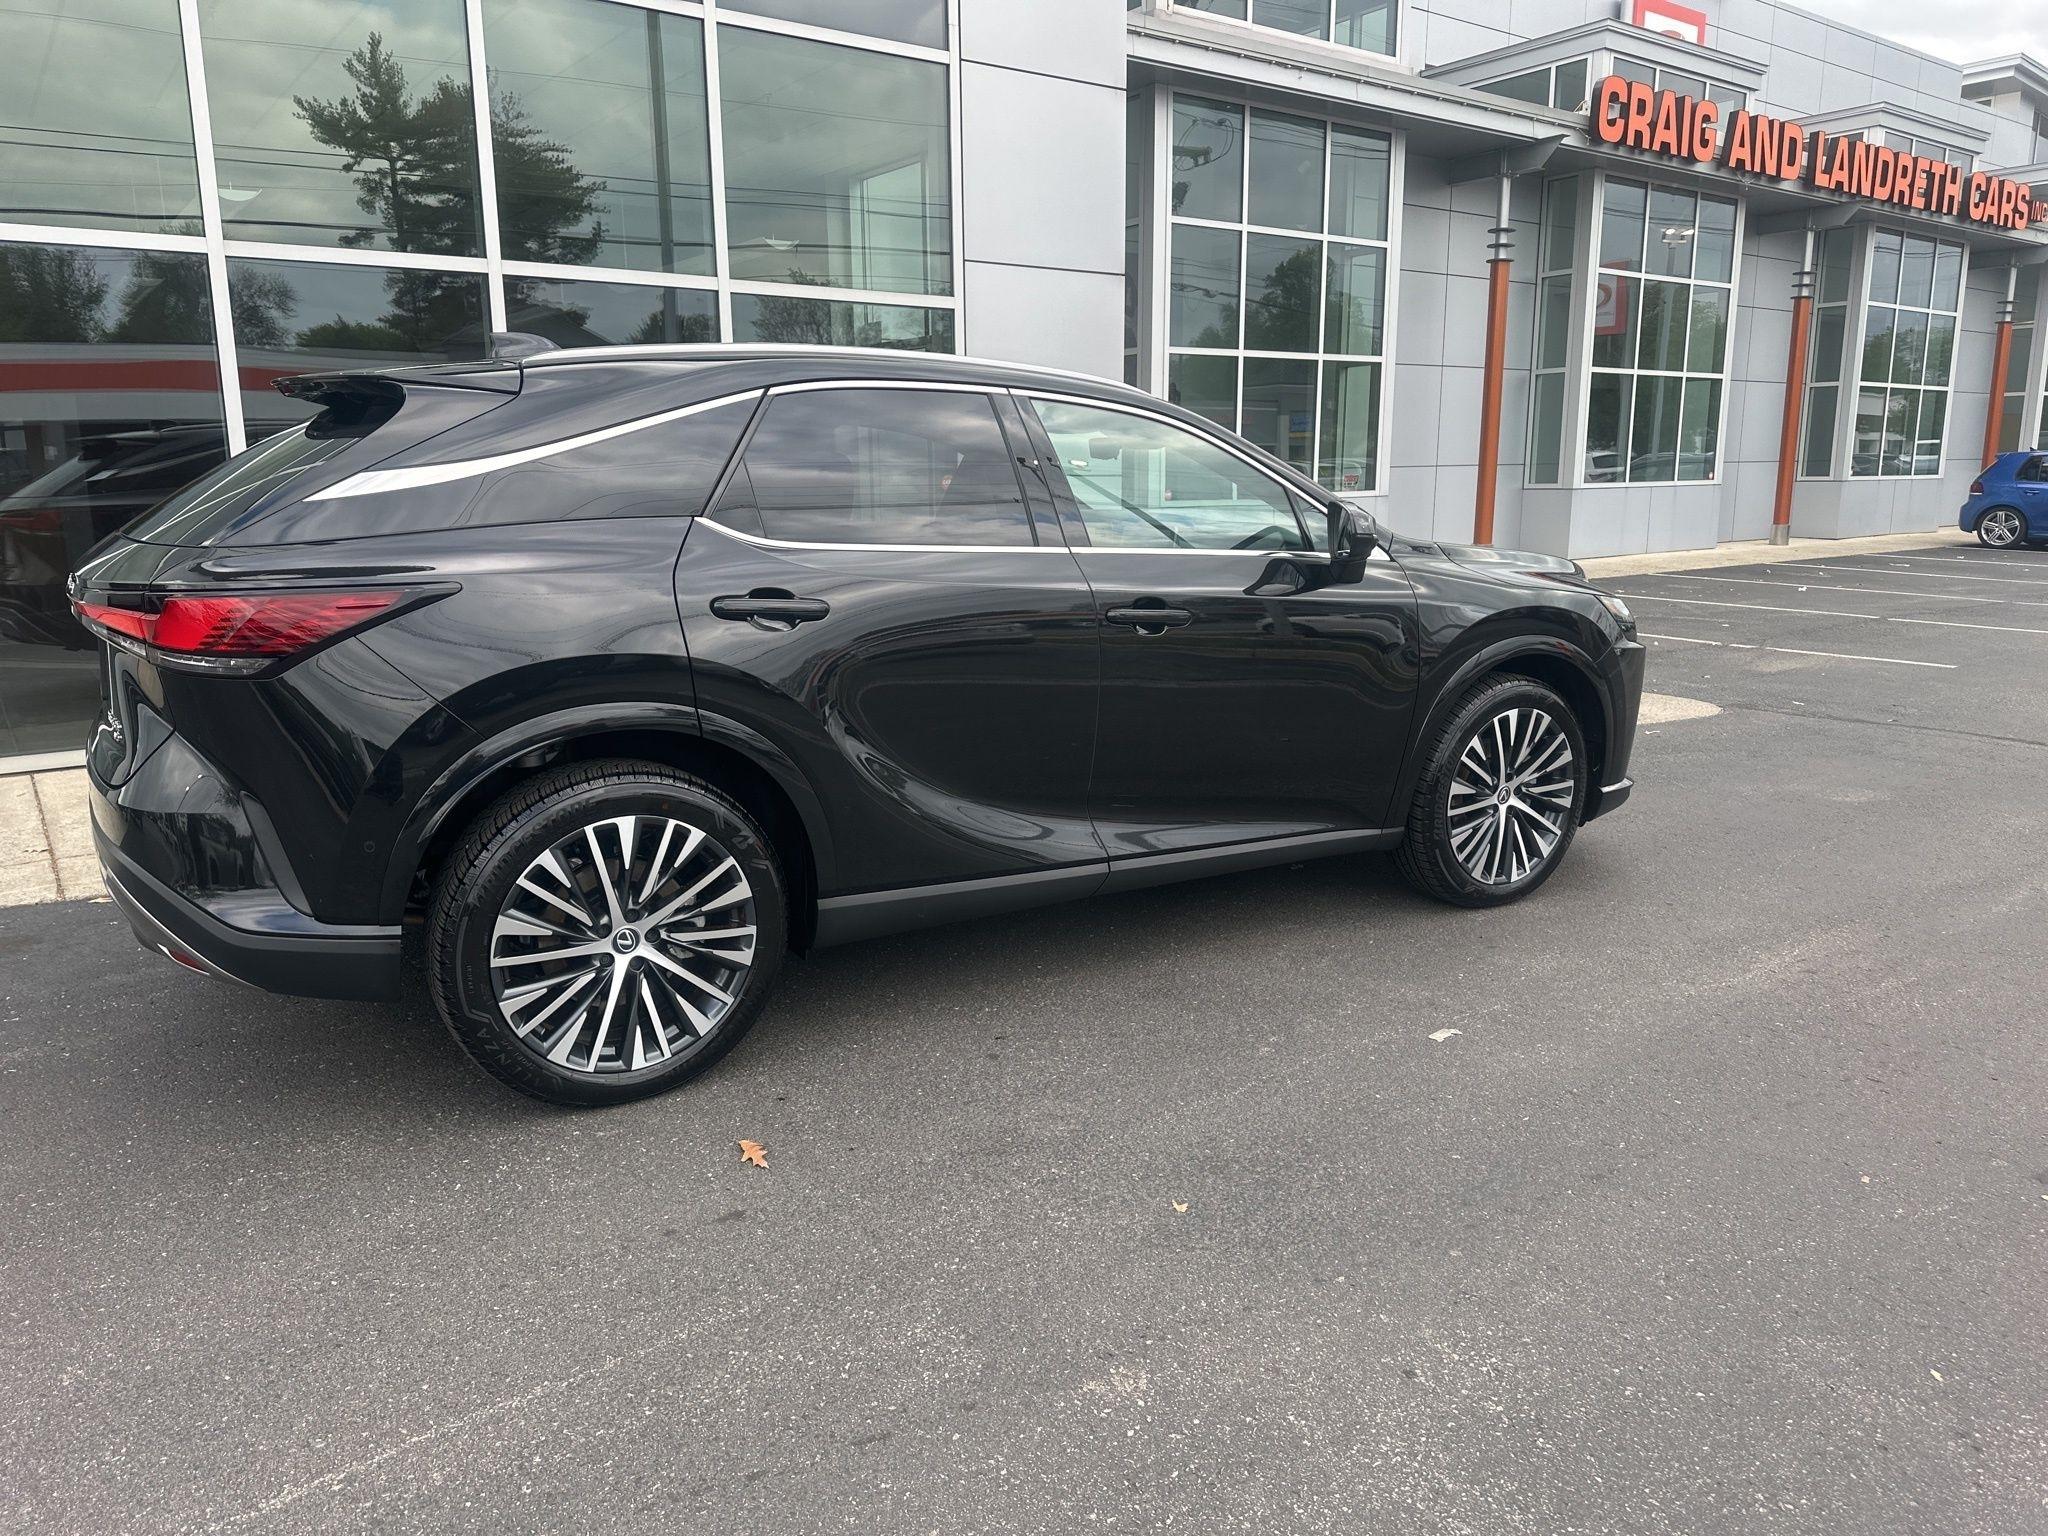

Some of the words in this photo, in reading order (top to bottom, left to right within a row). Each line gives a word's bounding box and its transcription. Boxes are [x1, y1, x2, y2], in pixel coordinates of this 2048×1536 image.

[1597, 75, 1718, 163] CRAIG
[1728, 109, 1804, 181] AND
[1813, 130, 1964, 216] LANDRETH
[1968, 171, 2031, 230] CARS
